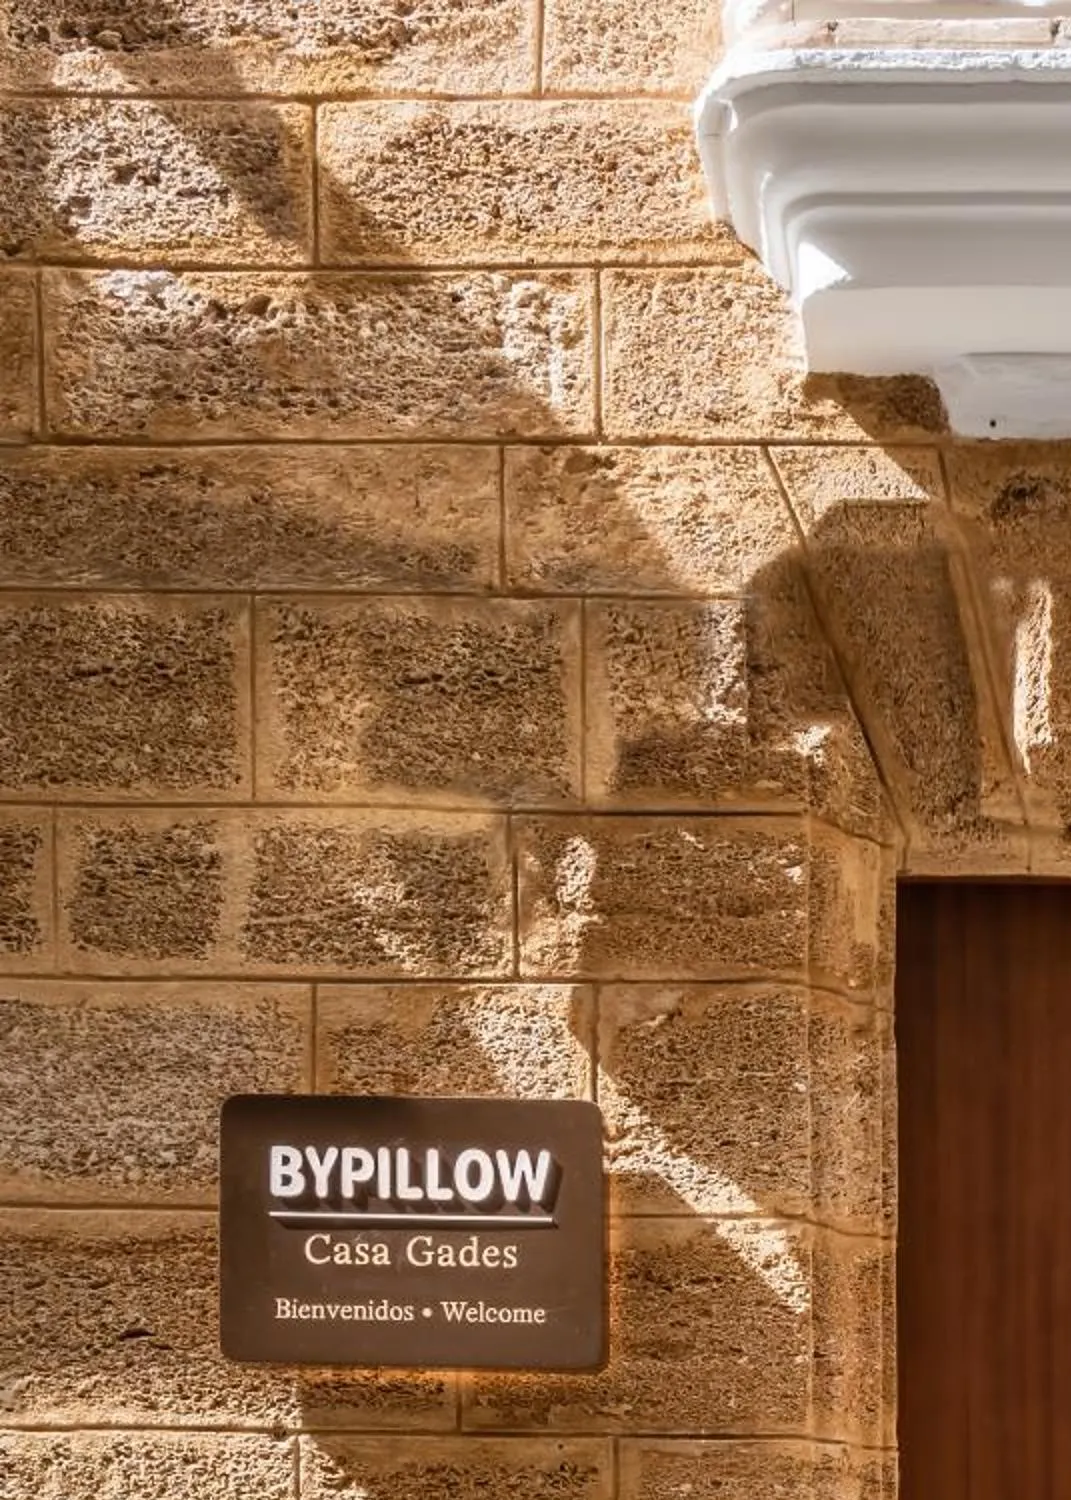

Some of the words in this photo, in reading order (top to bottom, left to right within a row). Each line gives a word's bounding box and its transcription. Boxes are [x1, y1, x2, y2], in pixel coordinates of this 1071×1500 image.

[268, 1145, 552, 1203] BYPILLOW
[303, 1233, 392, 1266] Casa
[405, 1235, 519, 1269] Gades
[274, 1297, 415, 1322] Bienvenidos
[439, 1301, 546, 1325] Welcome
